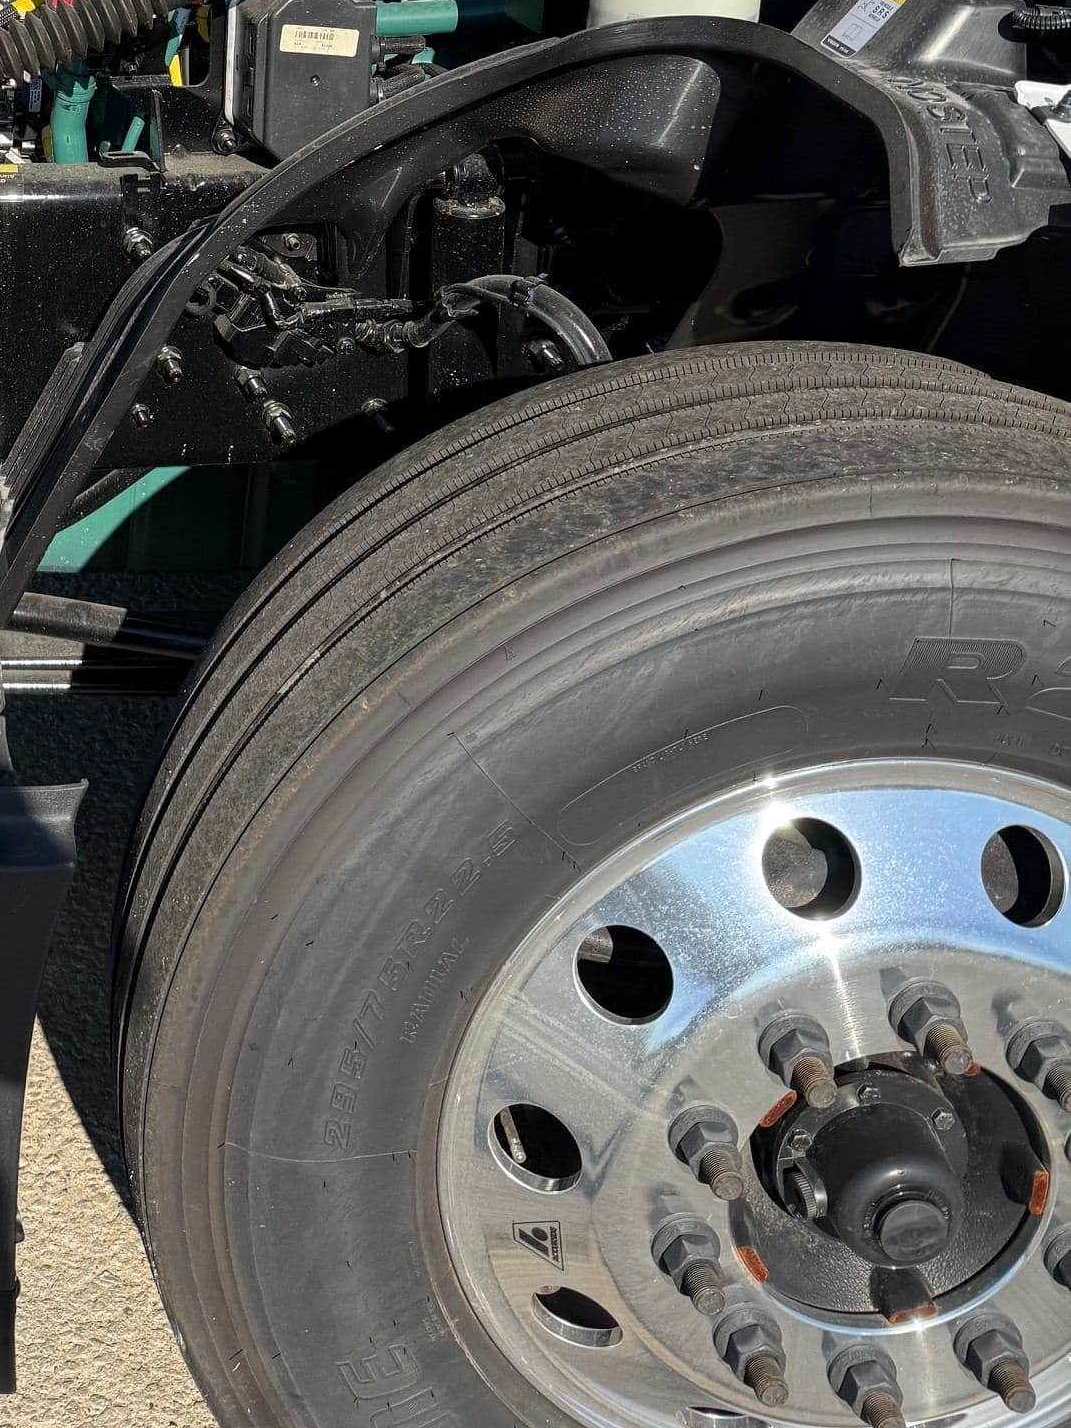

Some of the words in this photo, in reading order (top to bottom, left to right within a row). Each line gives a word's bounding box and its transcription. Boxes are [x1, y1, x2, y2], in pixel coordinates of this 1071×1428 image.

[872, 5, 890, 19] SRS
[323, 818, 516, 1151] 295/75R22.5
[550, 1225, 562, 1263] ACCURIDE
